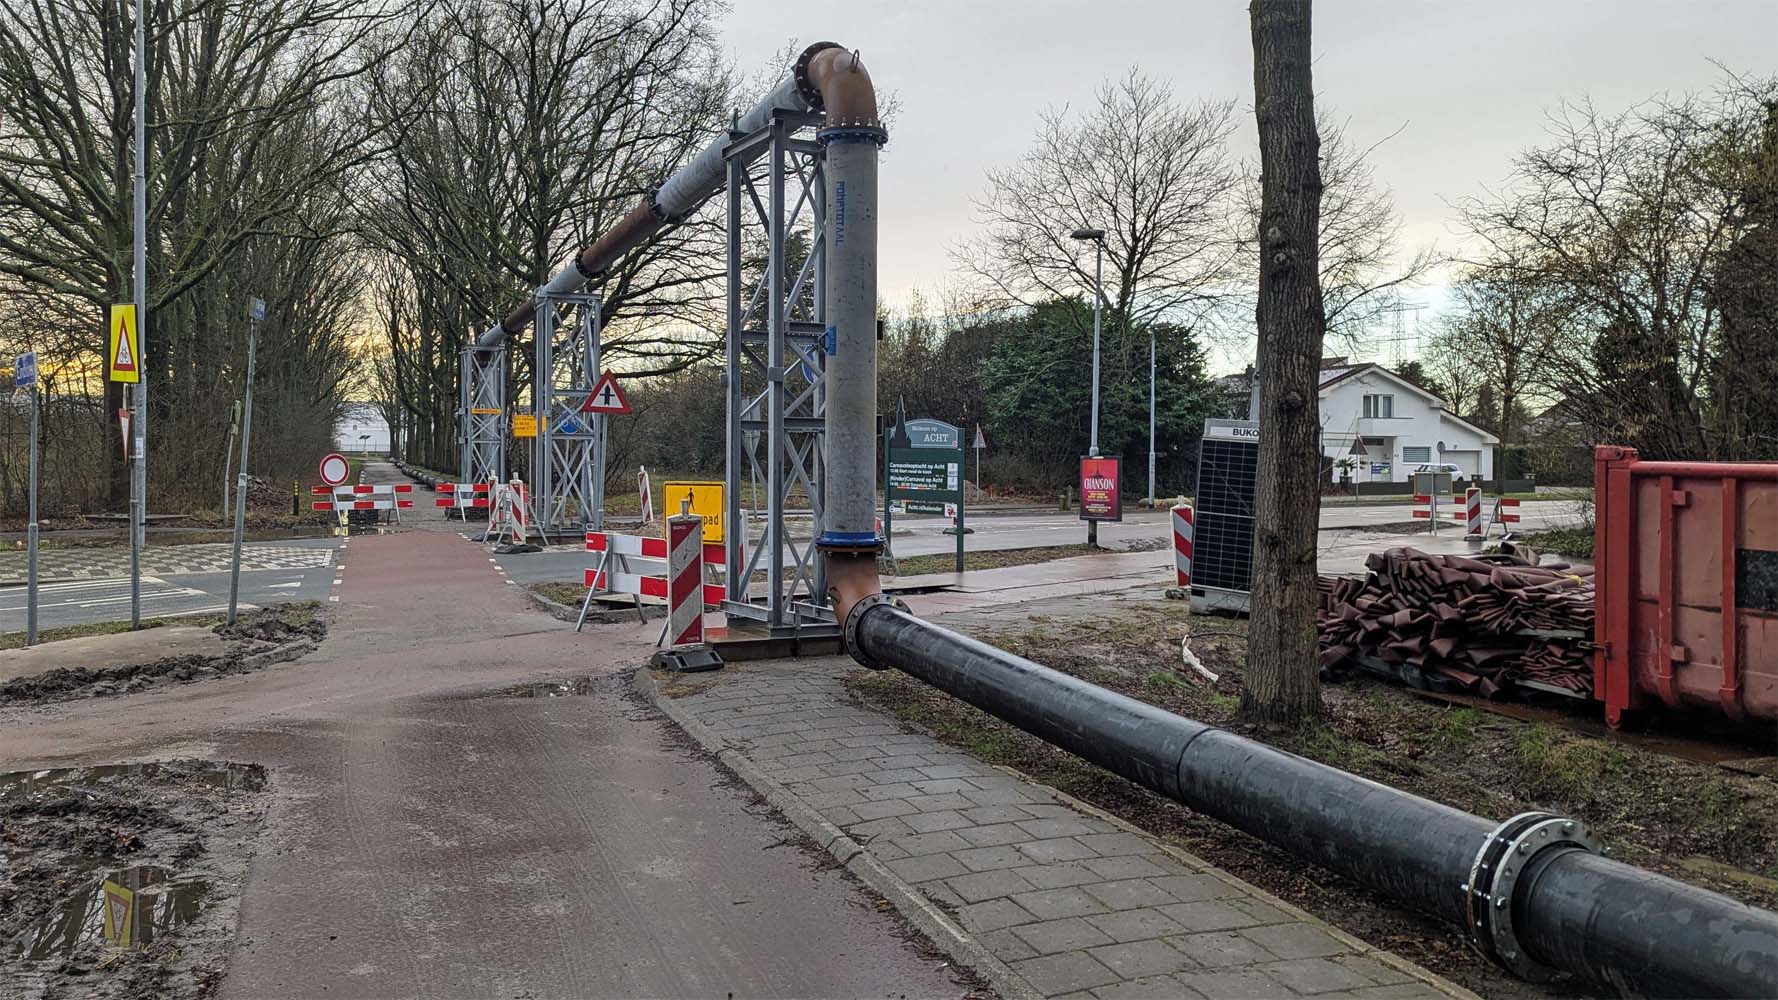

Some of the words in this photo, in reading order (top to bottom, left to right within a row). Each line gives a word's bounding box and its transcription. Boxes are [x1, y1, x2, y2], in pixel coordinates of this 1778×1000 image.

[1232, 428, 1259, 437] BUKO
[924, 433, 948, 442] ACHT
[1084, 478, 1114, 490] CHANSON
